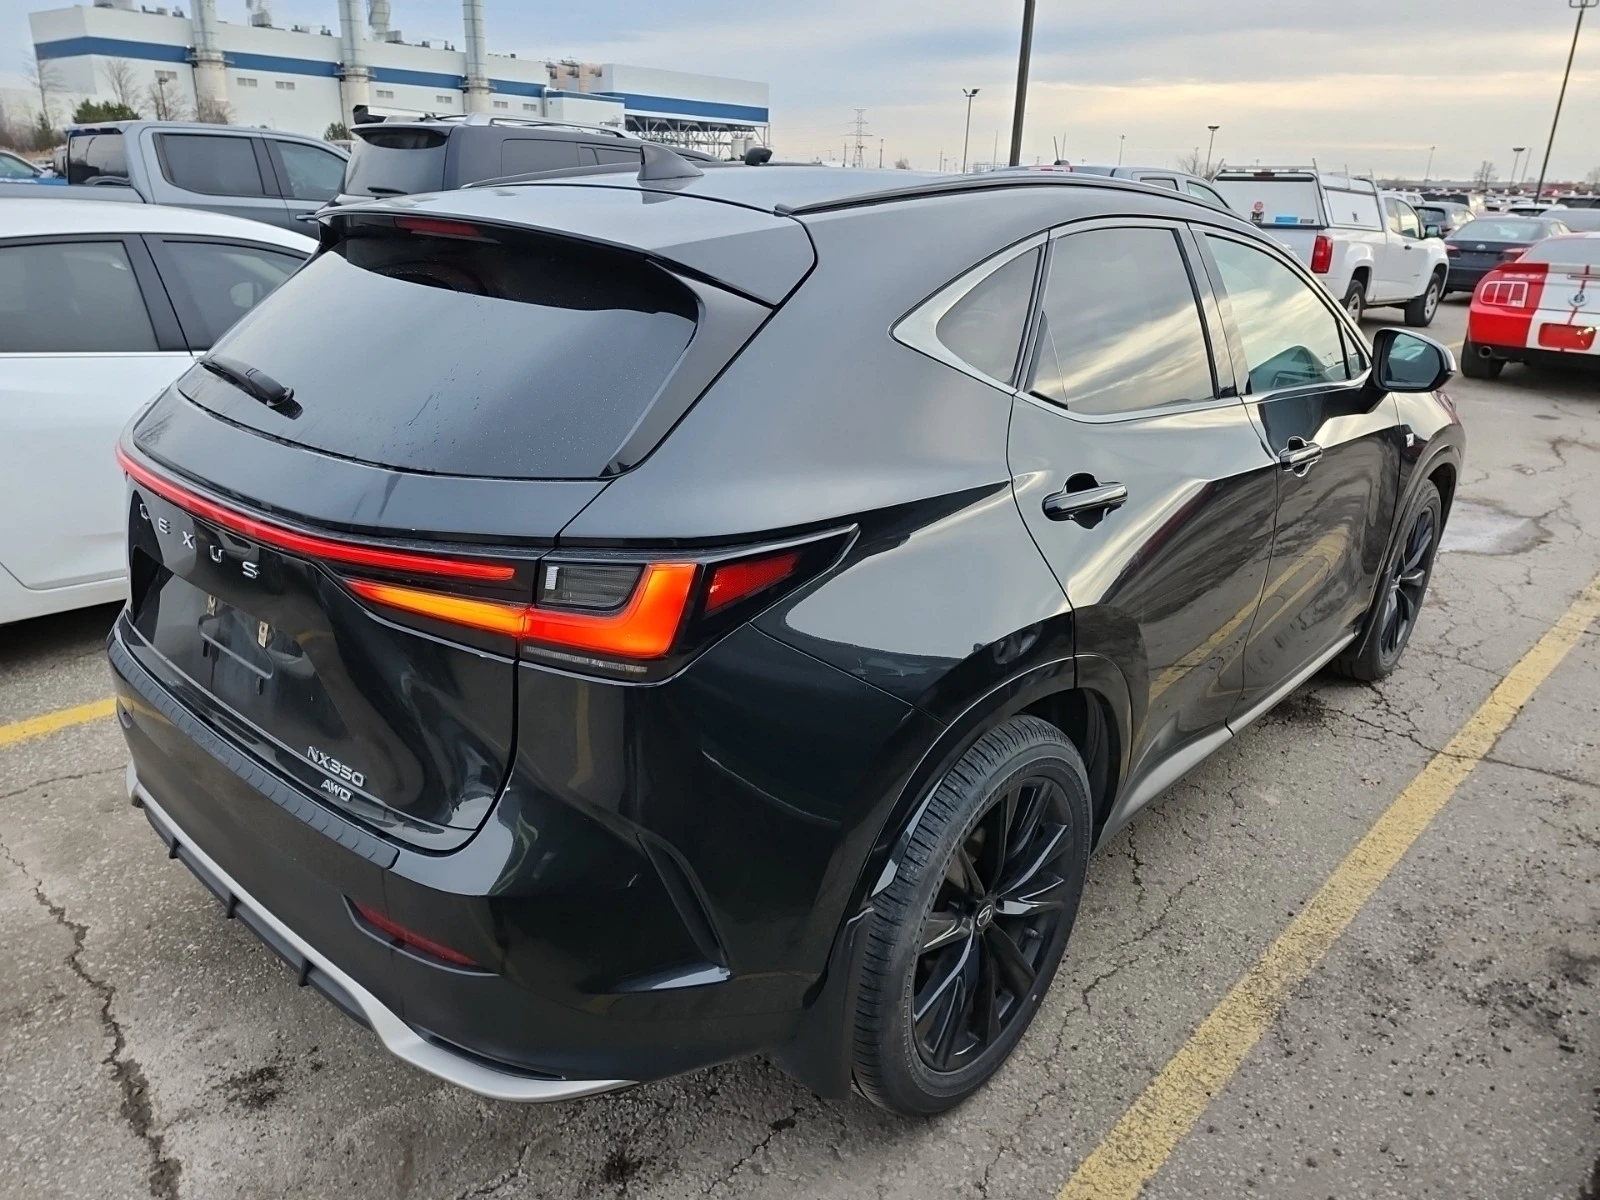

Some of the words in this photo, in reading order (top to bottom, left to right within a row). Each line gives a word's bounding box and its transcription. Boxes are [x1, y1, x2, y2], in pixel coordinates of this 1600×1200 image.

[139, 503, 260, 579] LEXUS
[307, 745, 366, 787] NX350
[320, 779, 354, 803] AWD
